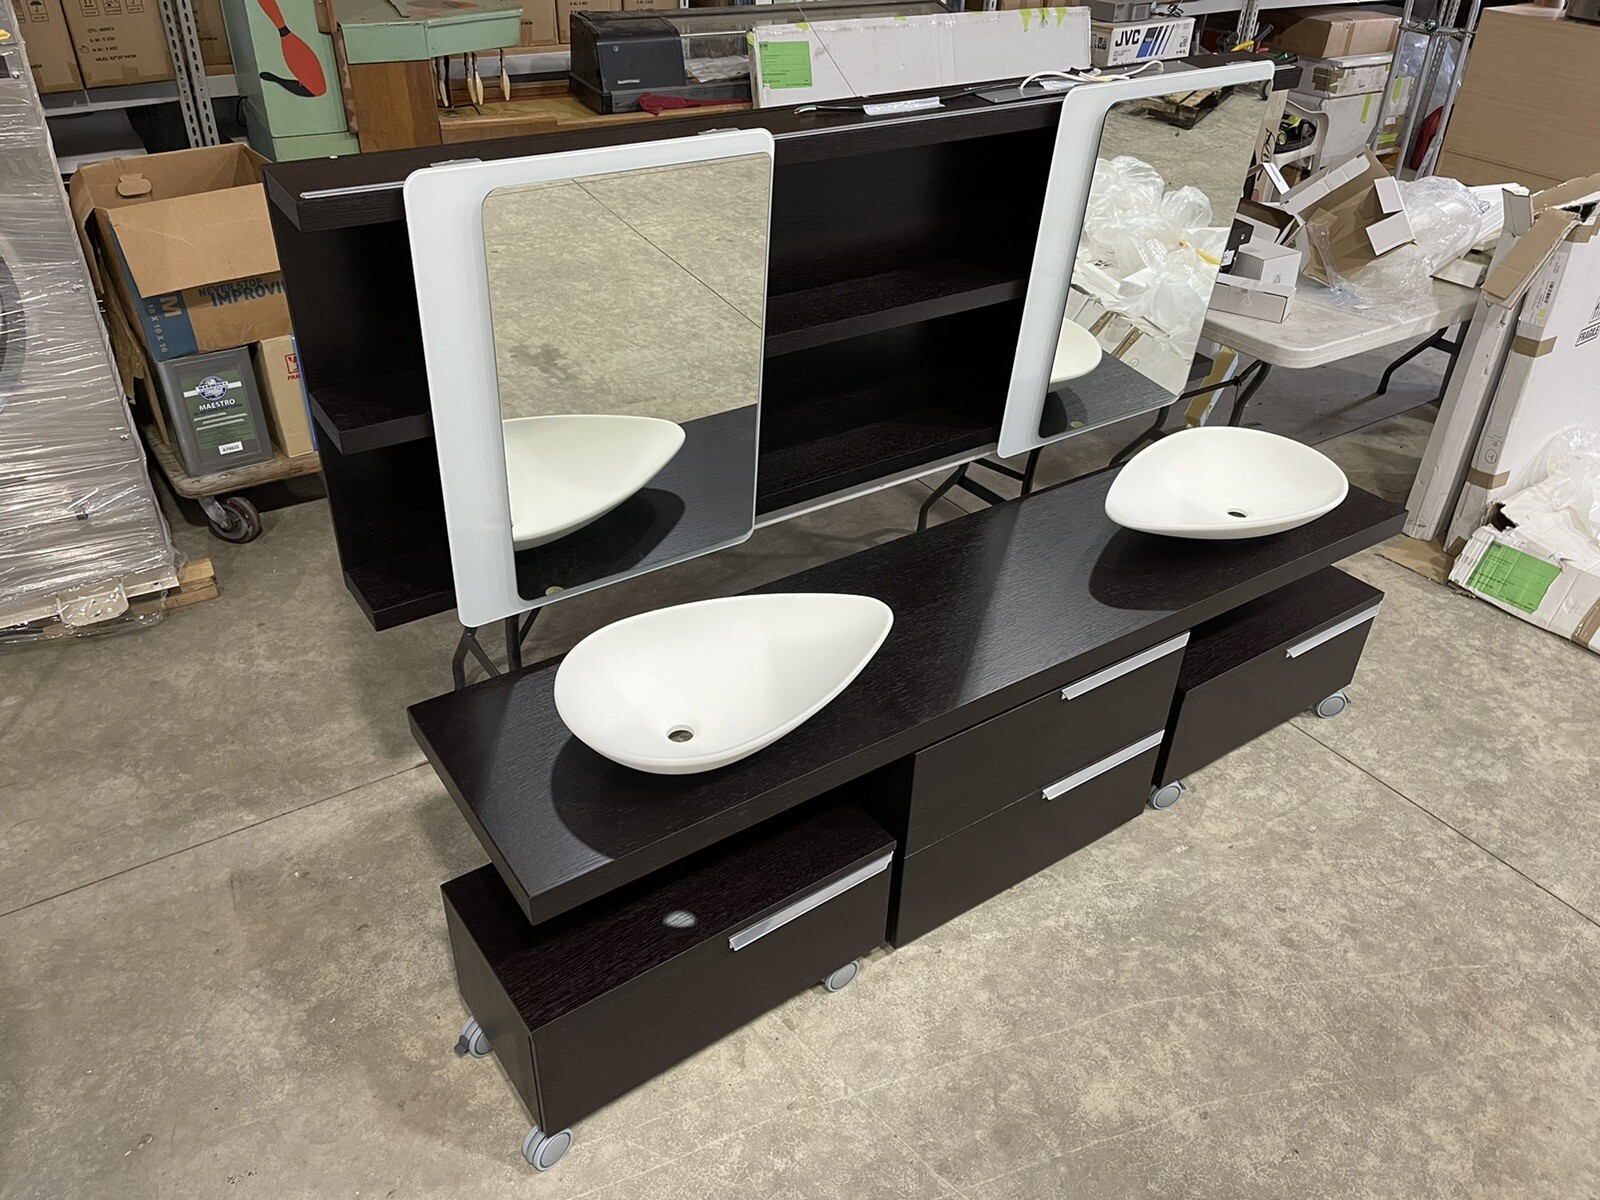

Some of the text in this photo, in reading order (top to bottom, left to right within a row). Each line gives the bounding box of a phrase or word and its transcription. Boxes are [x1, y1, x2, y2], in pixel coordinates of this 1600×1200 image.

[1115, 29, 1141, 48] JVC
[199, 277, 263, 297] NEVER STOP
[160, 295, 183, 318] M
[199, 398, 236, 411] MAESTRO
